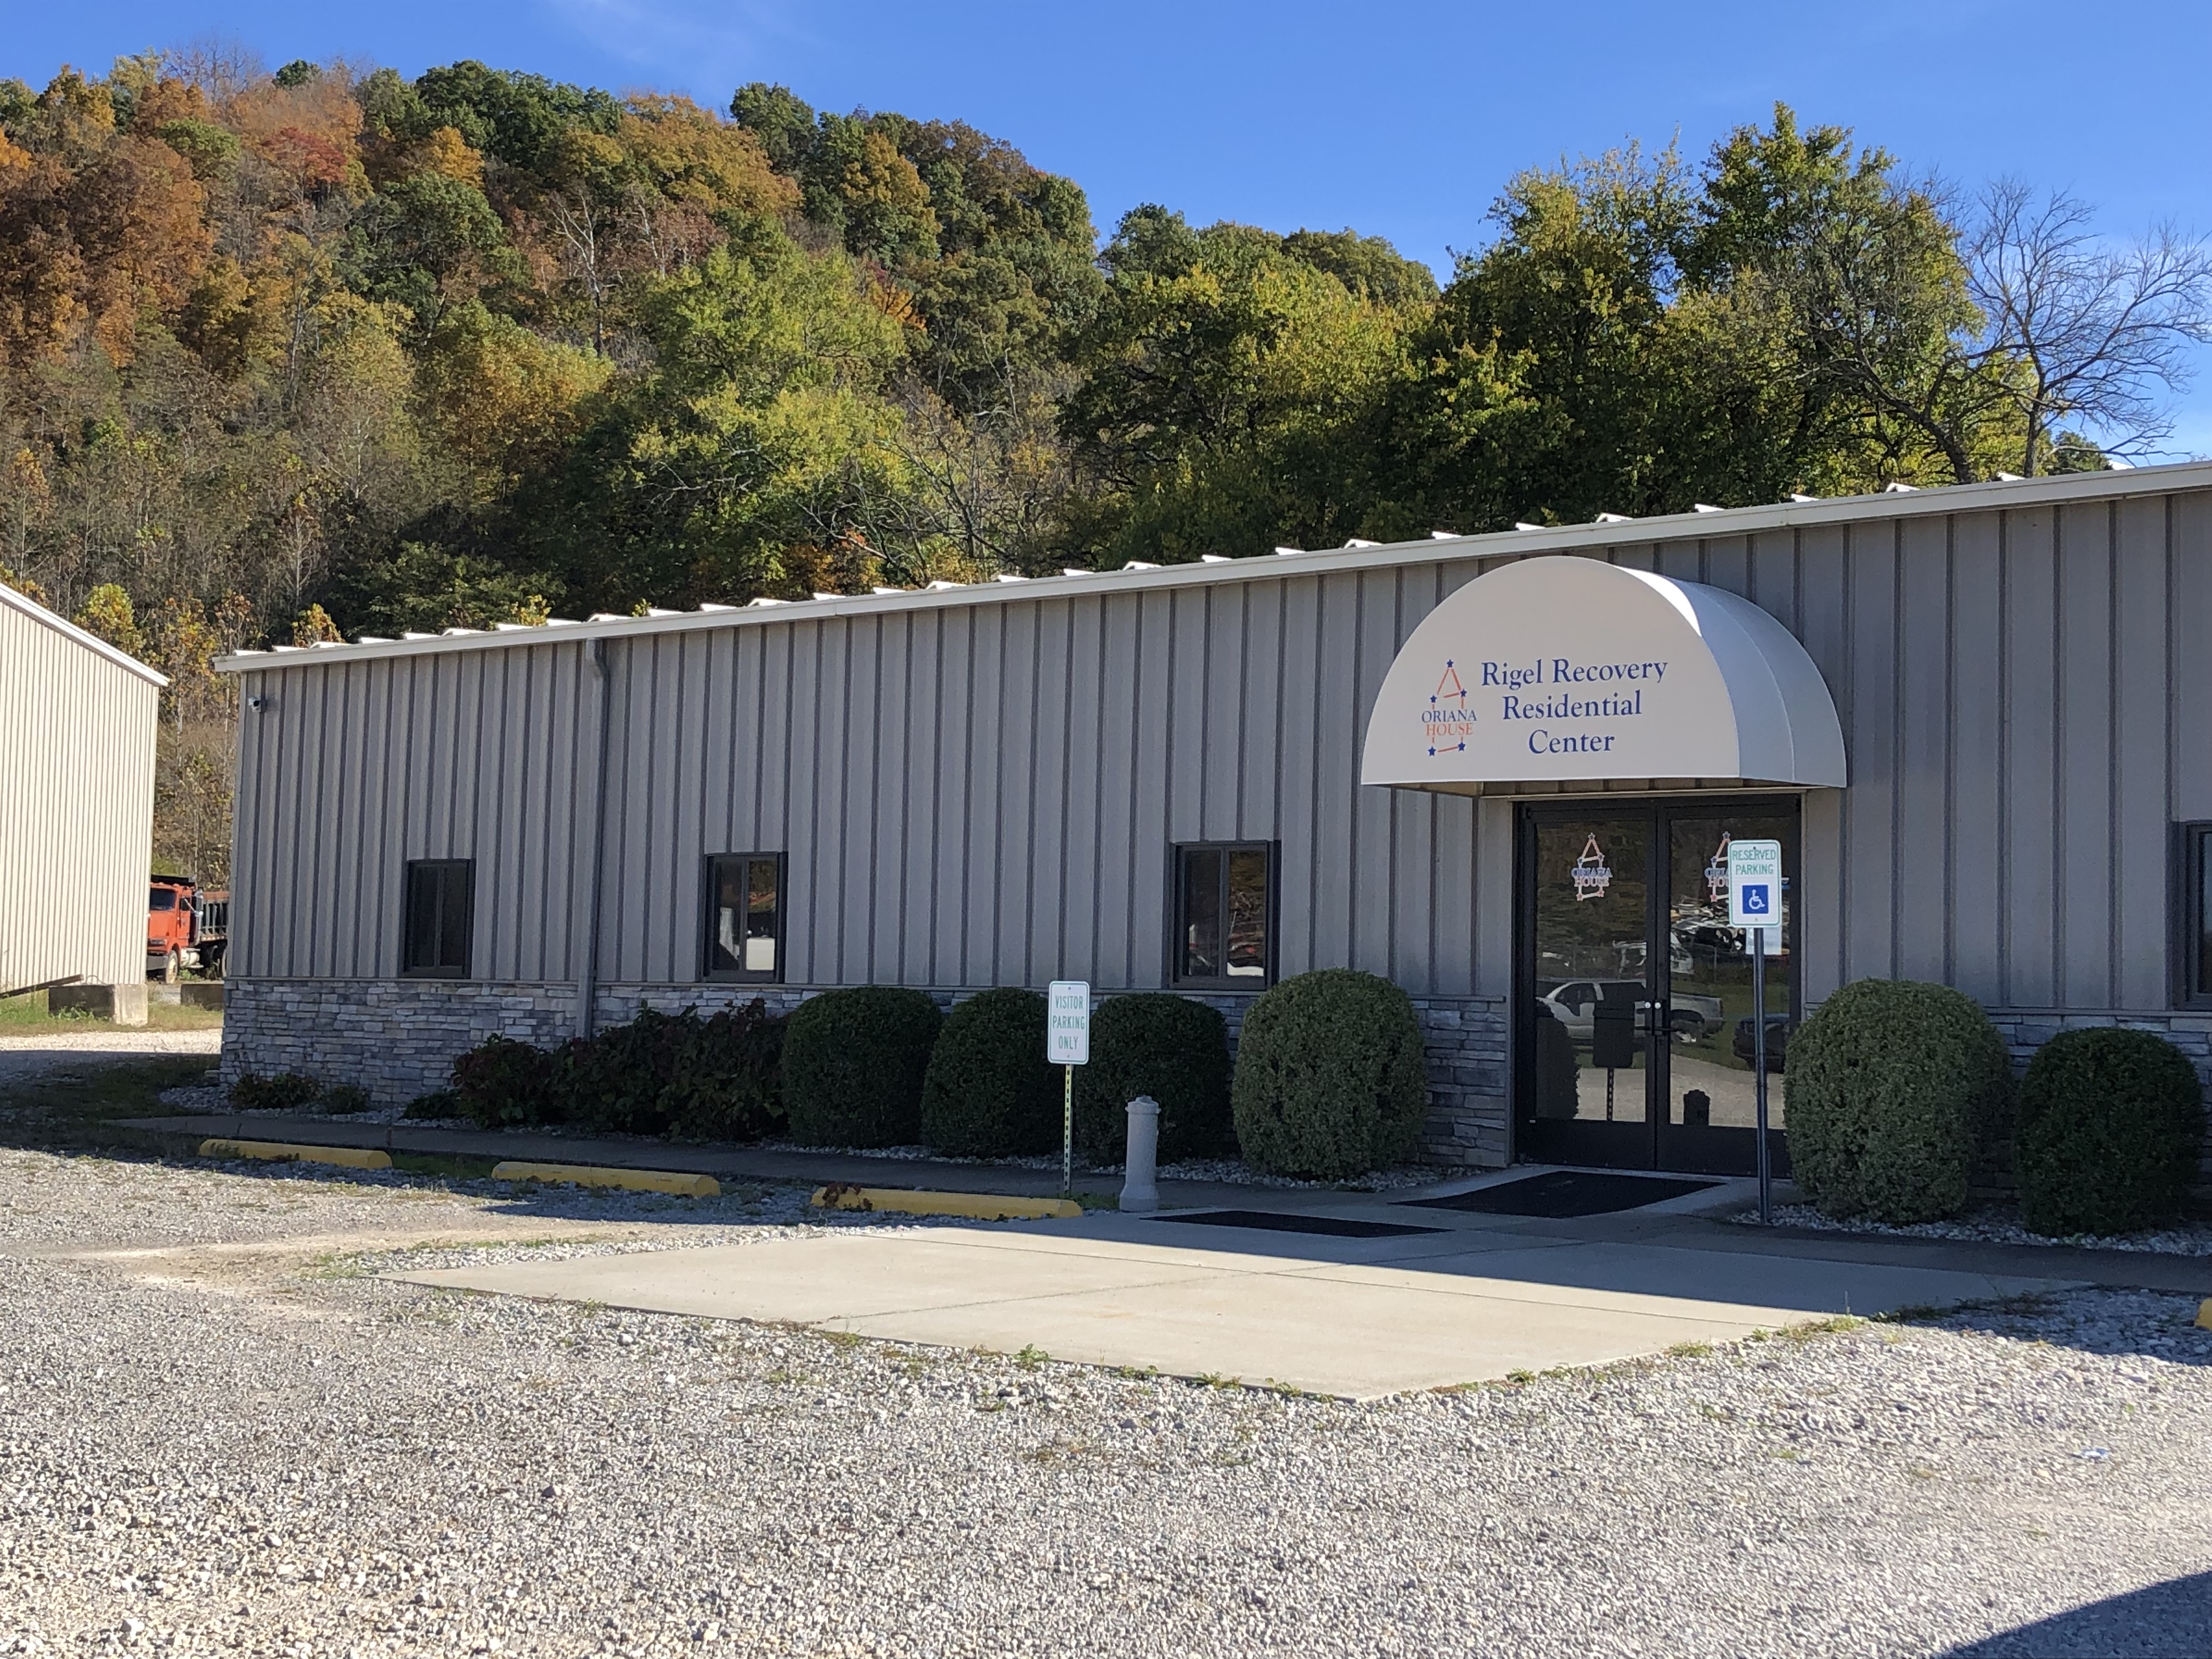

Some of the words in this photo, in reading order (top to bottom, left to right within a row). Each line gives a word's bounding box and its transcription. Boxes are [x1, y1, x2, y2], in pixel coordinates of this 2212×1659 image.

[1481, 659, 1543, 691] Rigel
[1552, 658, 1668, 684] Recovery
[1502, 690, 1642, 720] Residential
[1421, 709, 1477, 723] ORIANA
[1426, 723, 1474, 736] HOUSE
[1528, 729, 1615, 754] Center
[1732, 850, 1776, 861] RESERVED
[1735, 864, 1774, 875] PARKING
[1054, 995, 1084, 1010] VISITOR
[1052, 1015, 1085, 1030] PARKING
[1058, 1035, 1079, 1050] ONLY
